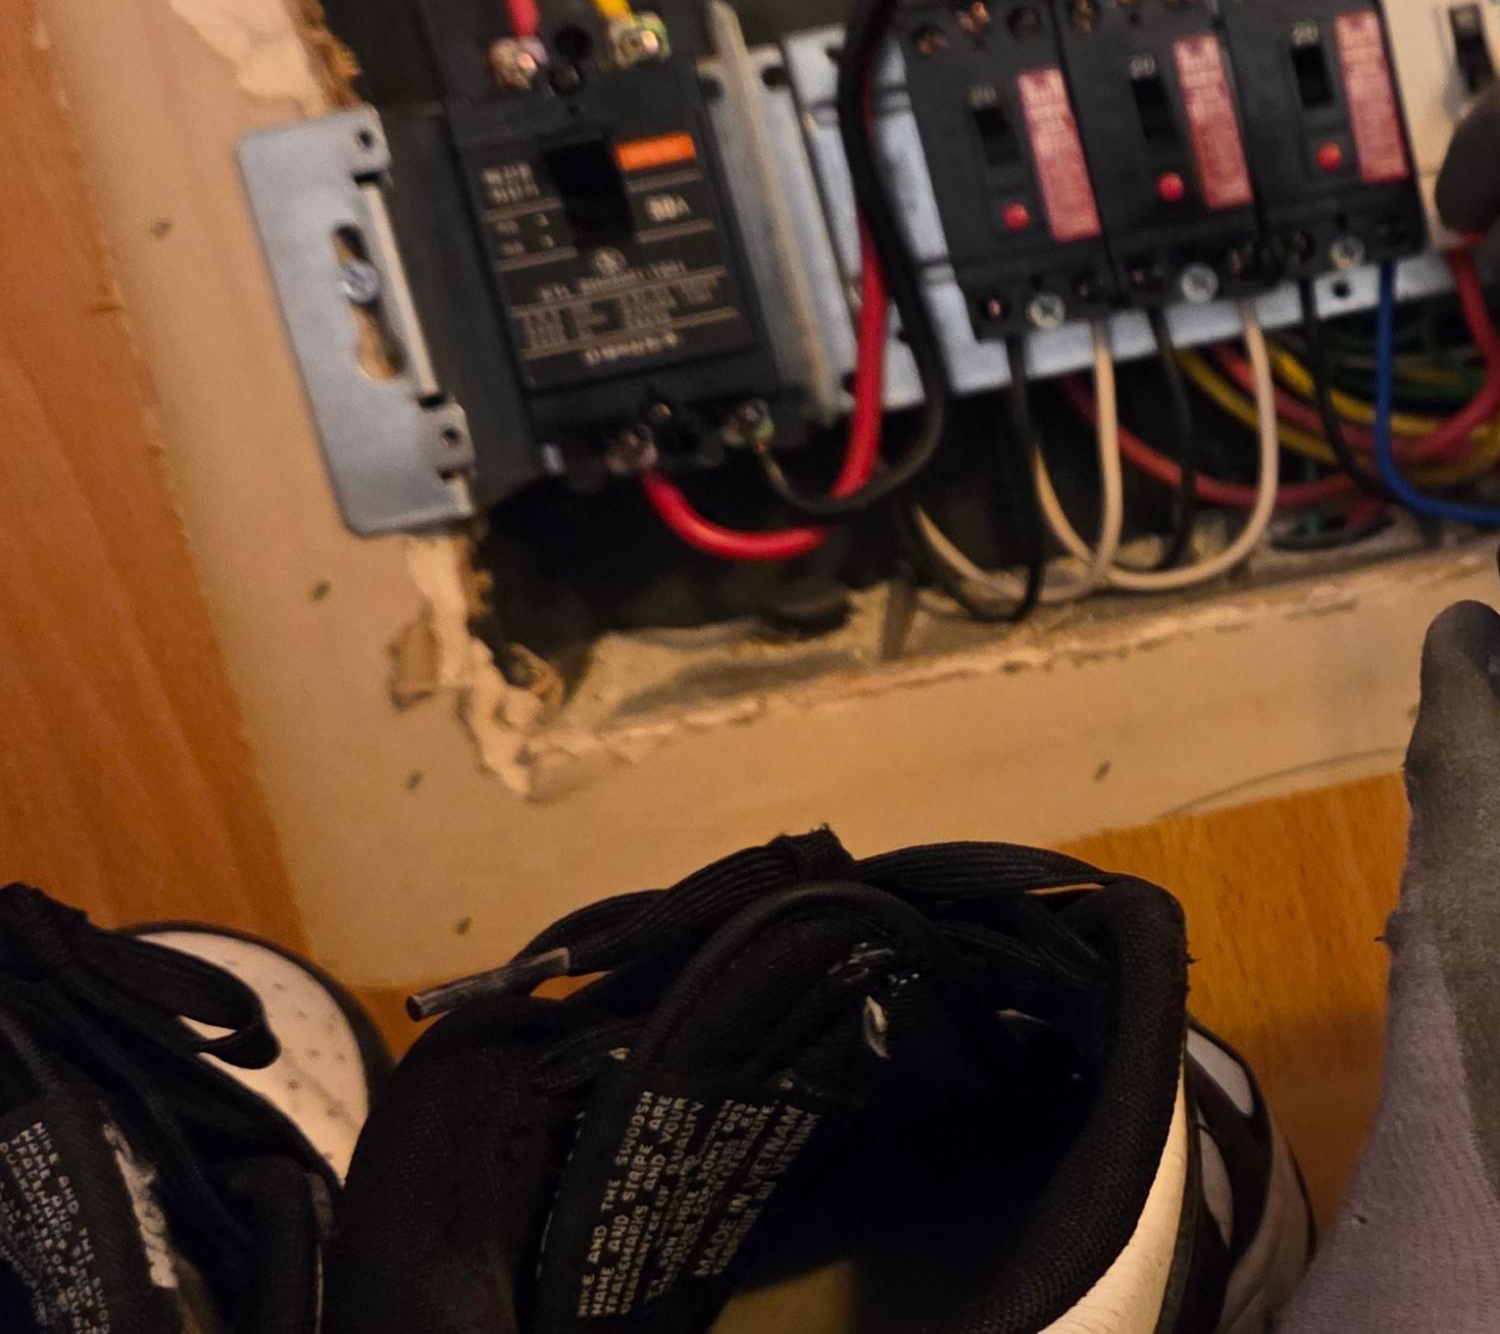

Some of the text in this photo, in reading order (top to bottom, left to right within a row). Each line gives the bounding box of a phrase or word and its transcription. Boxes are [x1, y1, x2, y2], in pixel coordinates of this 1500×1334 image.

[587, 1224, 608, 1264] AND
[601, 1178, 621, 1212] THE
[615, 1090, 654, 1165] SWOOSH
[607, 1213, 629, 1252] AND
[621, 1143, 653, 1202] STRIPE
[647, 1094, 672, 1130] ARE
[643, 1152, 666, 1191] AND
[658, 1096, 687, 1142] YOUR
